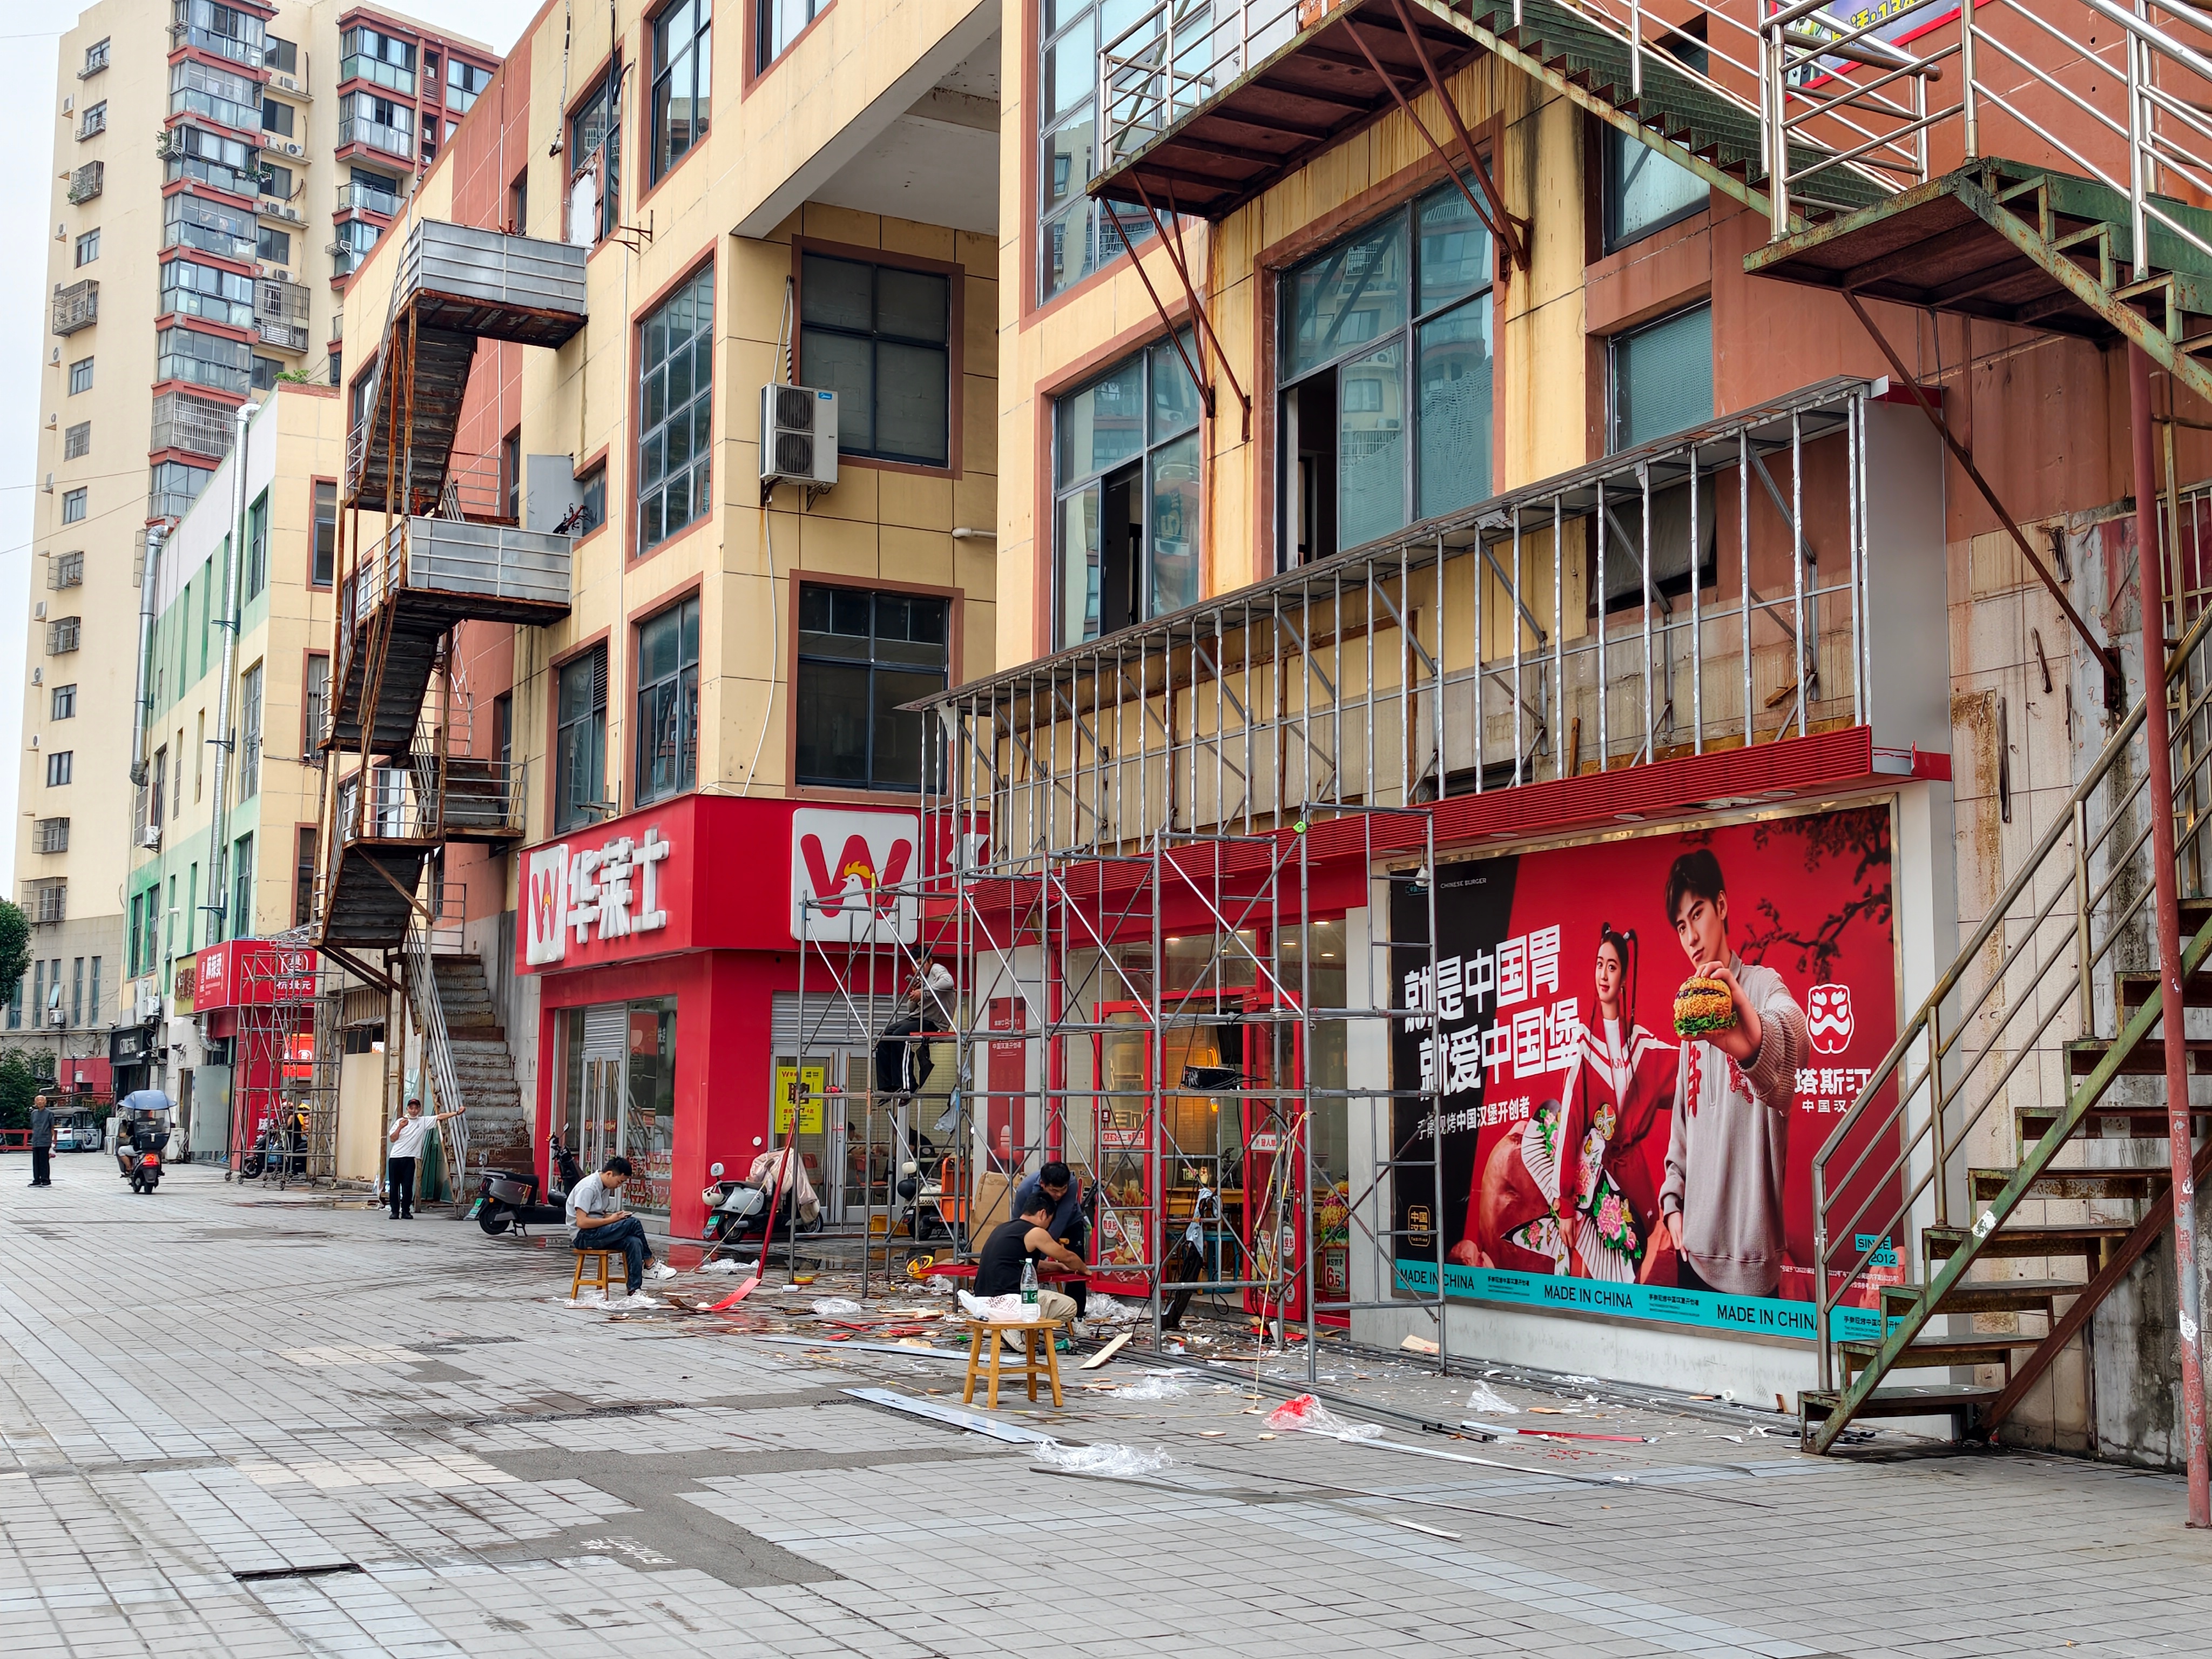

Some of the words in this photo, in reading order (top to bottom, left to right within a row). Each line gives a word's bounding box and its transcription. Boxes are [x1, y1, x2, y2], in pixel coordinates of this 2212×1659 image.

[568, 829, 670, 943] 华莱士
[1440, 880, 1464, 888] CHINESE
[1404, 924, 1560, 1034] 就是中国胃
[1419, 997, 1580, 1102] 就爱中国堡
[1795, 1068, 1871, 1095] 塔斯汀
[1802, 1099, 1858, 1113] 中国汉
[1411, 1211, 1428, 1223] 中国
[1871, 1253, 1896, 1264] 2012
[1400, 1269, 1427, 1284] MADE
[1429, 1272, 1439, 1285] IN
[1444, 1274, 1475, 1290] CHINA
[1545, 1285, 1576, 1301] MADE
[1579, 1288, 1591, 1303] IN
[1594, 1291, 1633, 1309] CHINA
[1717, 1304, 1755, 1323] MADE
[1759, 1309, 1773, 1325] IN
[1778, 1311, 1818, 1331] CHIN
